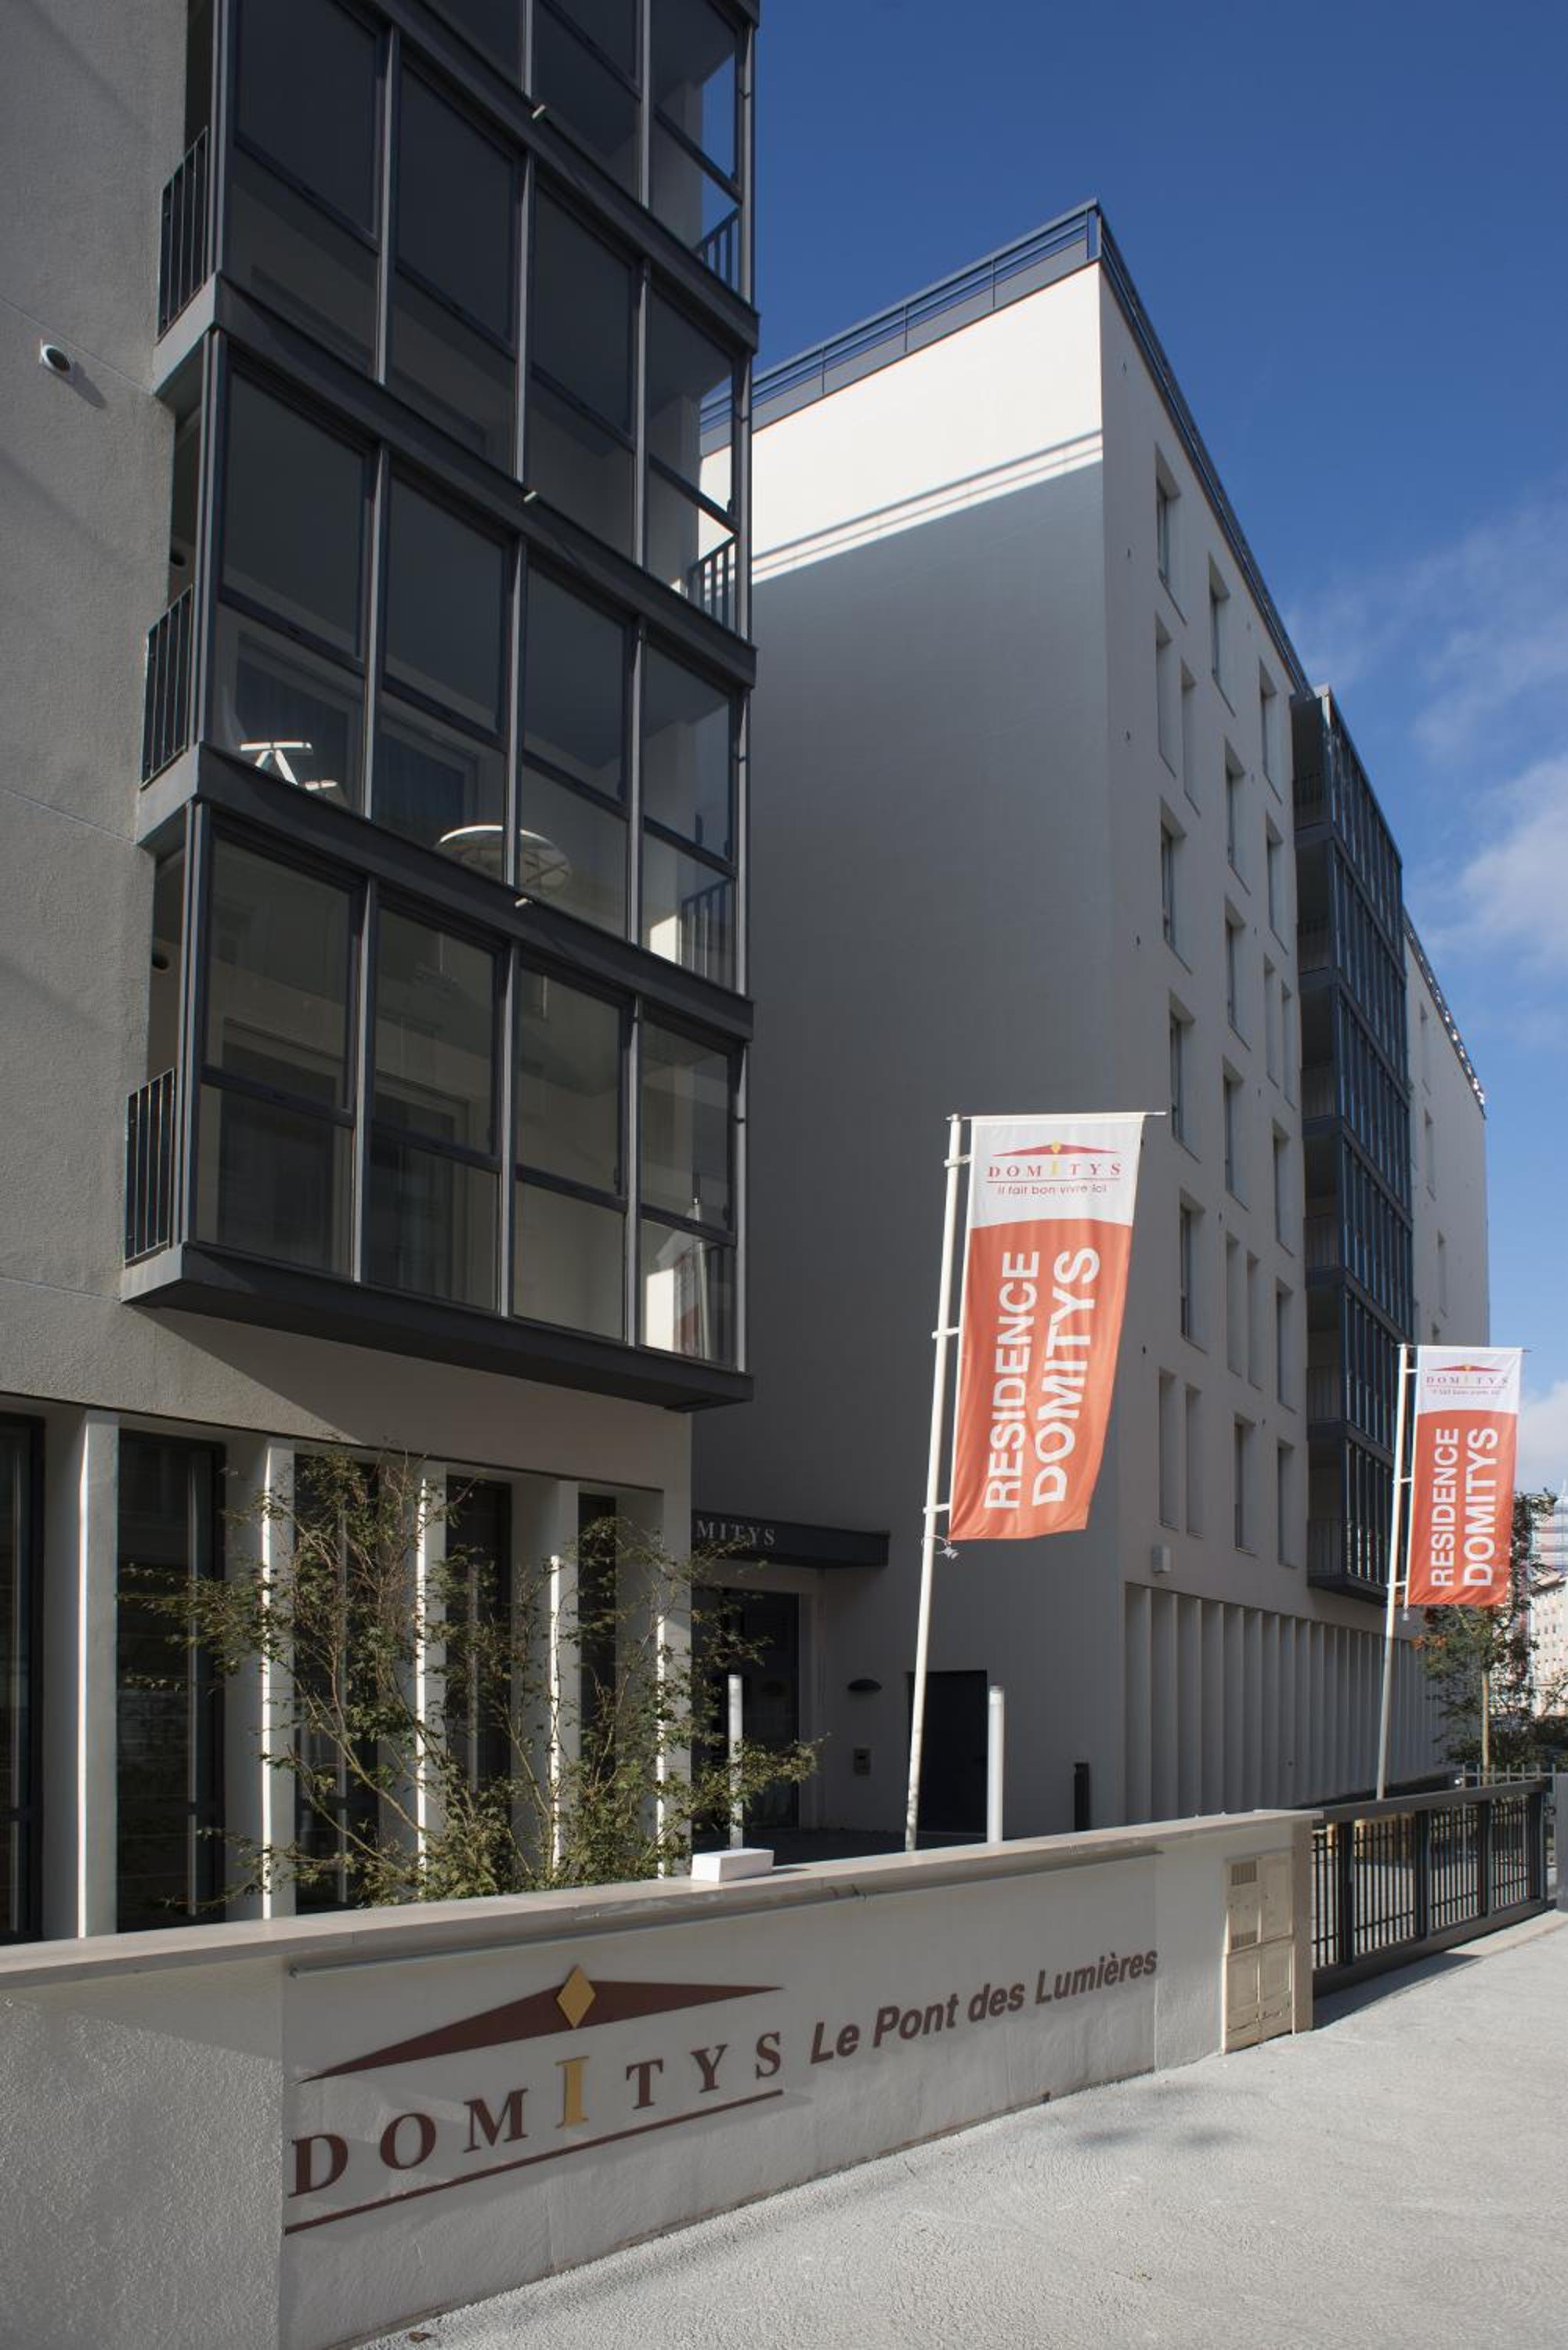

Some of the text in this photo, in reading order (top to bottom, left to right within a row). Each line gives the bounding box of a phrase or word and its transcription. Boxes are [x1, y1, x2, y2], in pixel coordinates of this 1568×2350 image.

[988, 1161, 1122, 1177] DOMITYS
[1009, 1184, 1028, 1195] fait
[1031, 1184, 1056, 1195] bon
[984, 1251, 1039, 1508] RESIDENCE
[1032, 1247, 1100, 1506] DOMITYS
[697, 1520, 775, 1546] MITYS
[1431, 1428, 1459, 1587] RESIDENCE
[1462, 1428, 1499, 1586] DOMITYS
[810, 1949, 1158, 2064] Le Pont des Lumières
[288, 2031, 782, 2198] DOMITYS
